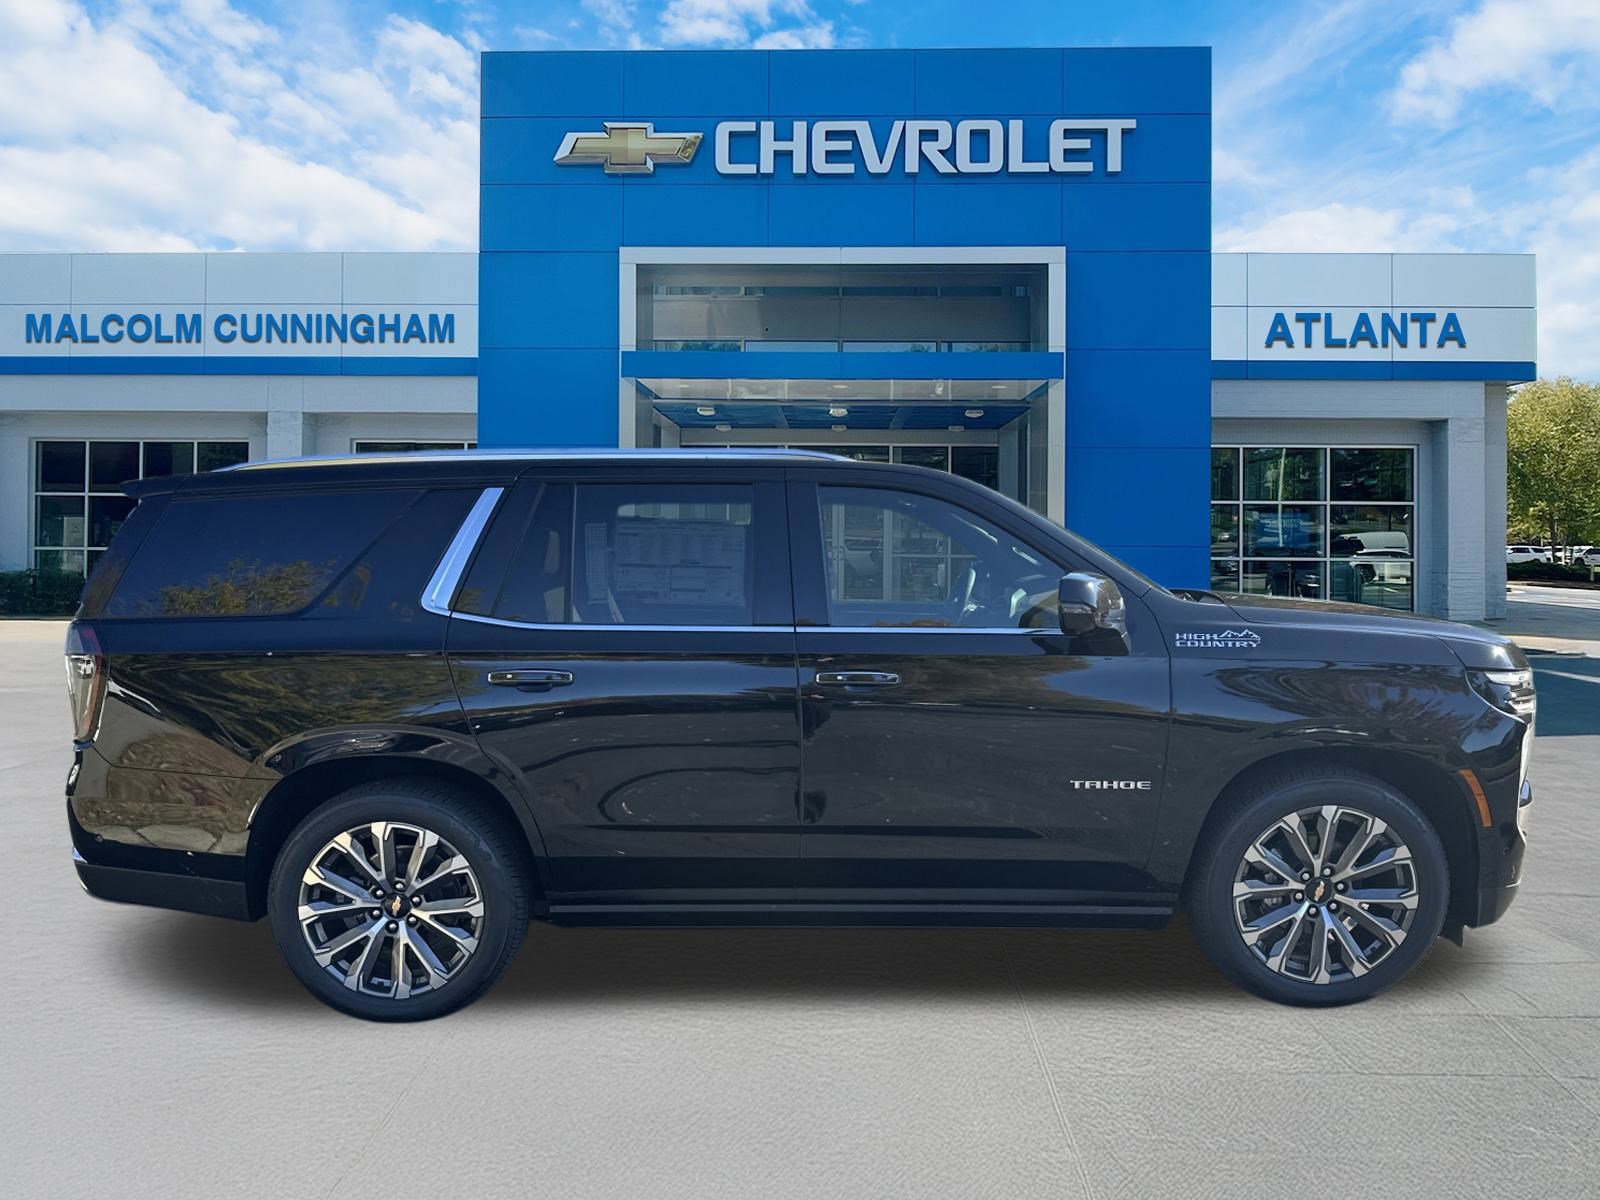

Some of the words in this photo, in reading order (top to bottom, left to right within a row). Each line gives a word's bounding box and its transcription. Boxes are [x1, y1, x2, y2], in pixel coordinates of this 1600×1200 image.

[715, 118, 1137, 175] CHEVROLET
[25, 313, 203, 344] MALCOLM
[214, 313, 456, 344] CUNNINGHAM
[1264, 312, 1467, 348] ATLANTA
[1175, 633, 1219, 641] HIGH
[1175, 640, 1260, 648] COUNTRY
[1069, 780, 1152, 790] TAHOE
